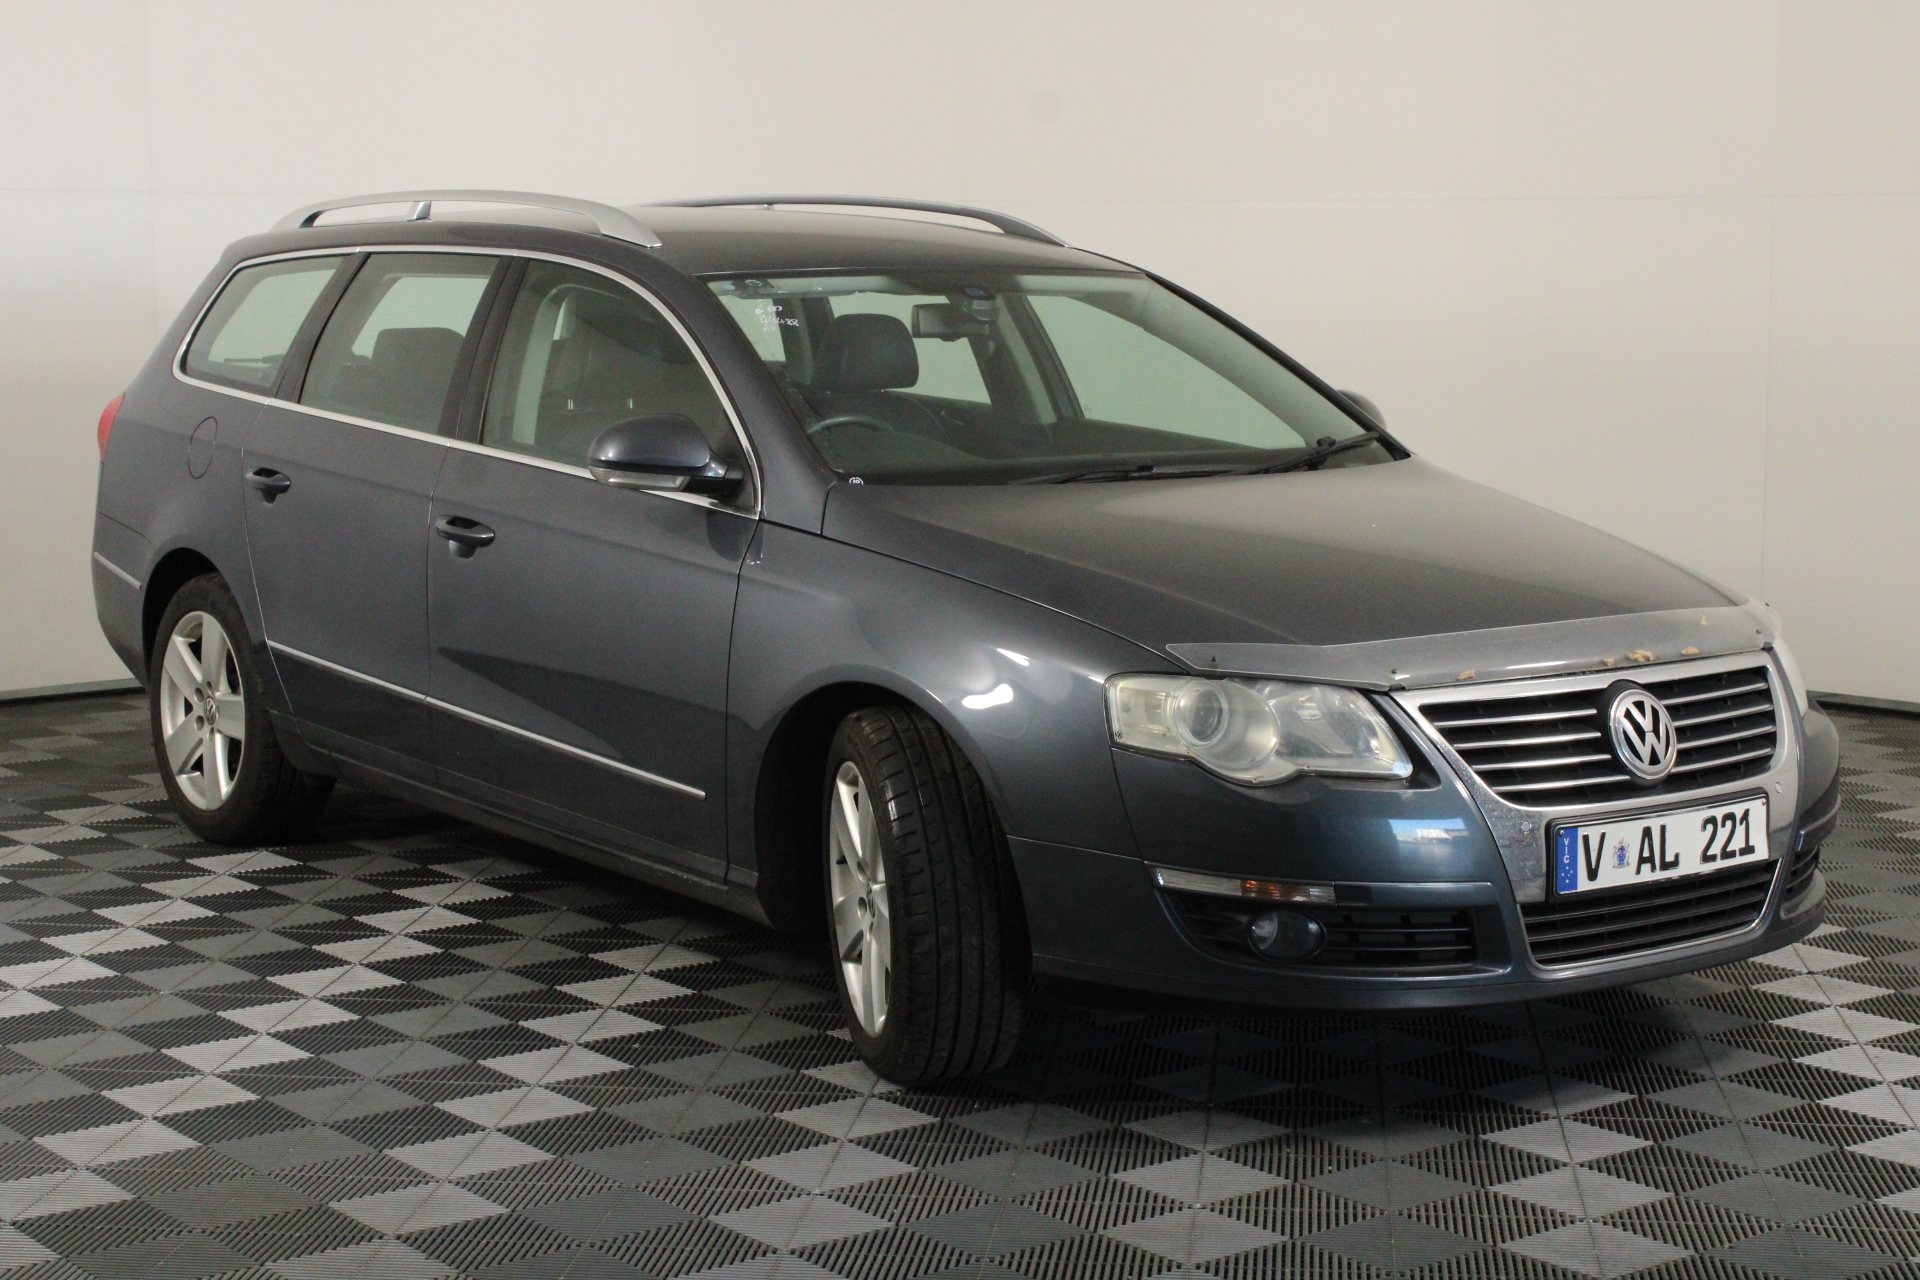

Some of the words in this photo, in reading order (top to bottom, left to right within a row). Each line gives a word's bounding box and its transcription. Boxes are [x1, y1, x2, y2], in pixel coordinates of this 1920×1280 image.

[1611, 692, 1675, 776] VW
[1582, 830, 1606, 882] V
[1635, 823, 1680, 876] AL
[1700, 808, 1756, 864] 221
